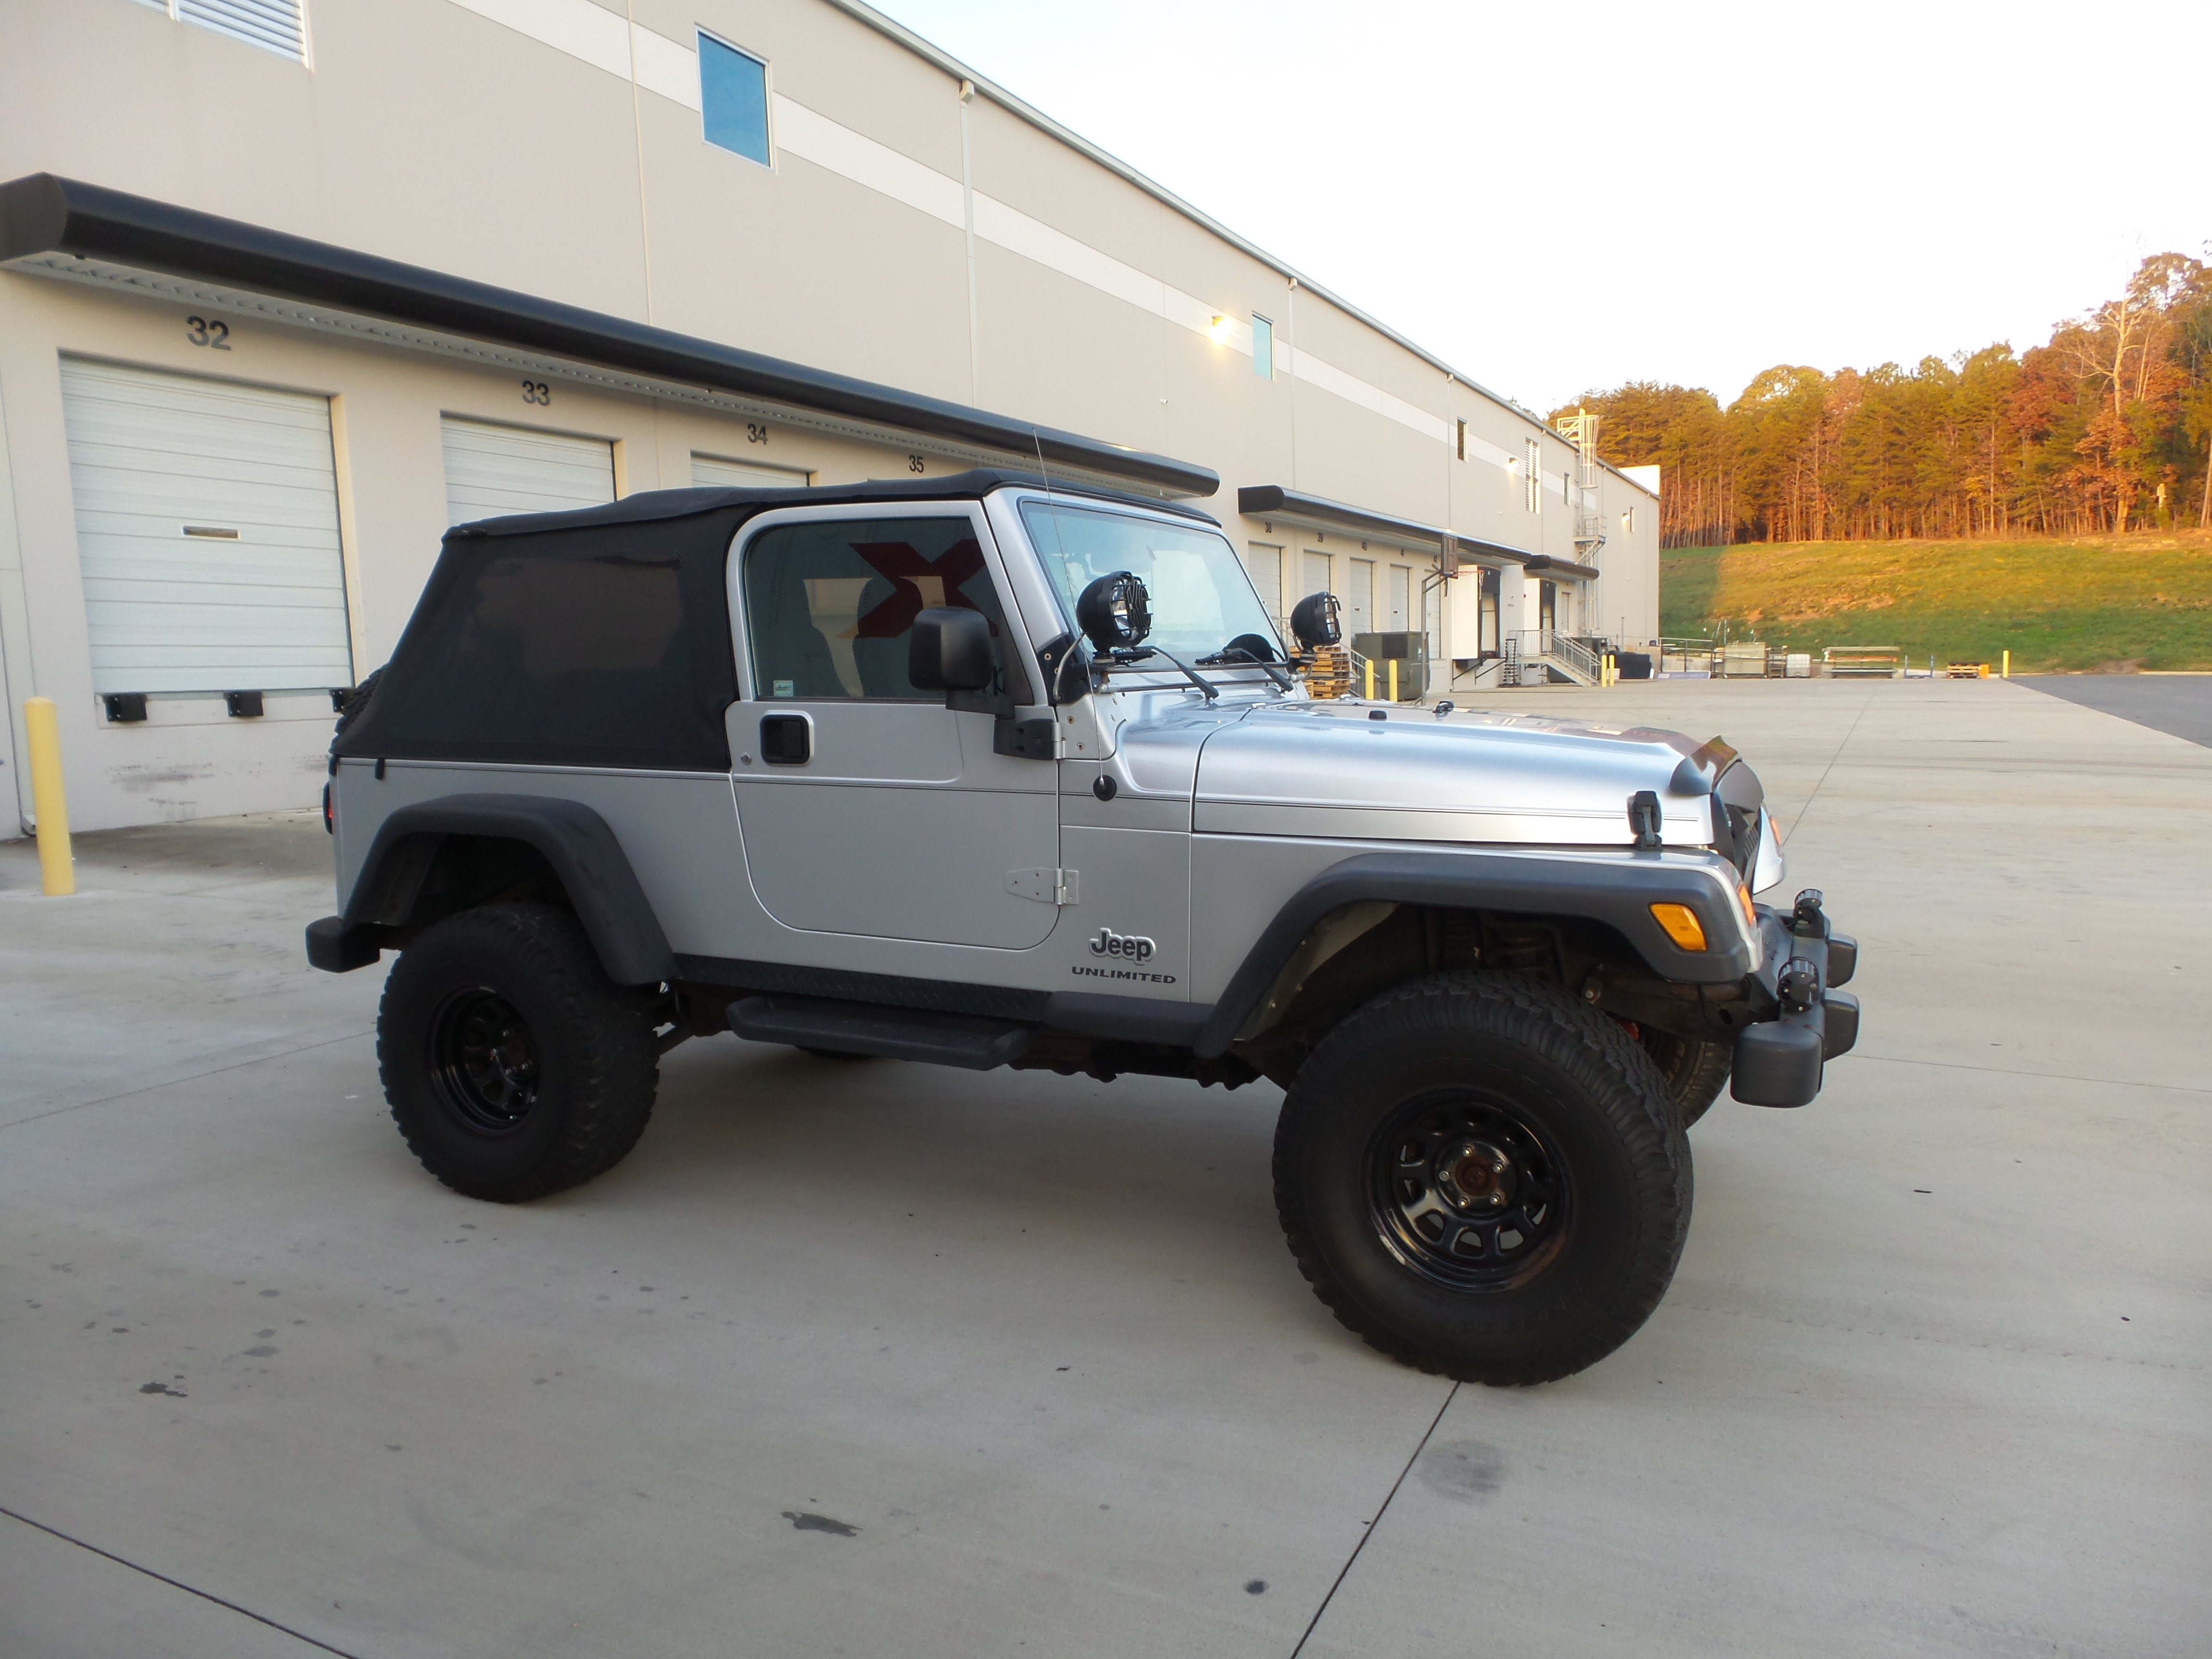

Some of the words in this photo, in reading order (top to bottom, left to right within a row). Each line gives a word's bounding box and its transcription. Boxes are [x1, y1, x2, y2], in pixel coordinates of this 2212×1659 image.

[186, 315, 231, 350] 32
[522, 380, 550, 406] 33
[747, 423, 768, 445] 34
[909, 454, 924, 473] 35
[1265, 522, 1272, 533] 38
[1318, 531, 1323, 542] 39
[1090, 930, 1153, 963] Jeep
[1071, 966, 1177, 984] UNLIMITED
